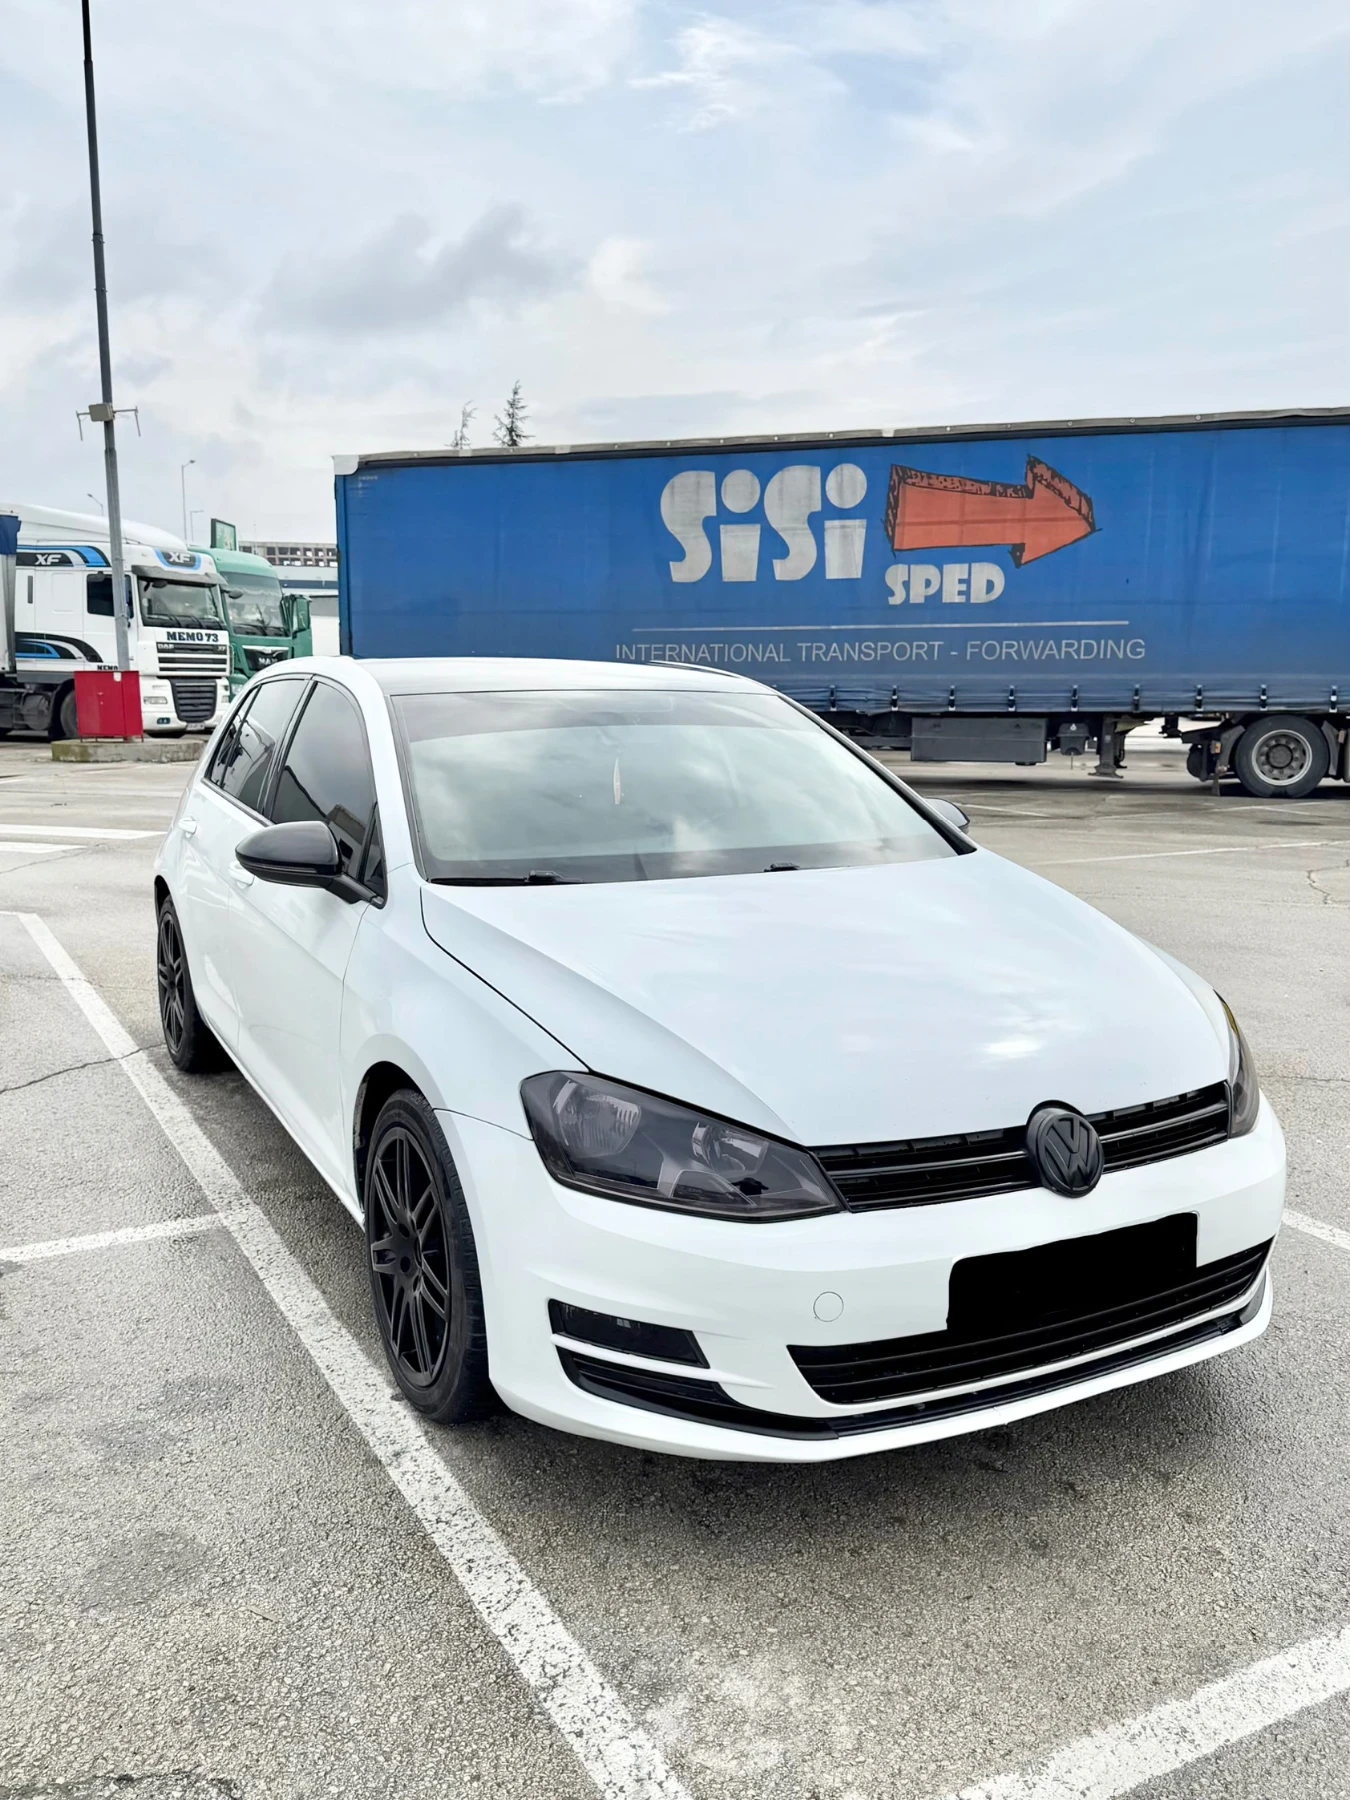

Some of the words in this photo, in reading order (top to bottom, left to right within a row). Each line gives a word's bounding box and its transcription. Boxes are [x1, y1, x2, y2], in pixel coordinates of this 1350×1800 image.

[35, 553, 62, 565] XF
[168, 551, 192, 564] XF
[885, 562, 1005, 605] SPED
[166, 631, 204, 642] MEMO
[205, 633, 219, 642] 73
[616, 644, 791, 663] INTERNATIONAL
[797, 641, 944, 661] TRANSPORT
[966, 639, 1147, 660] FORWARDING
